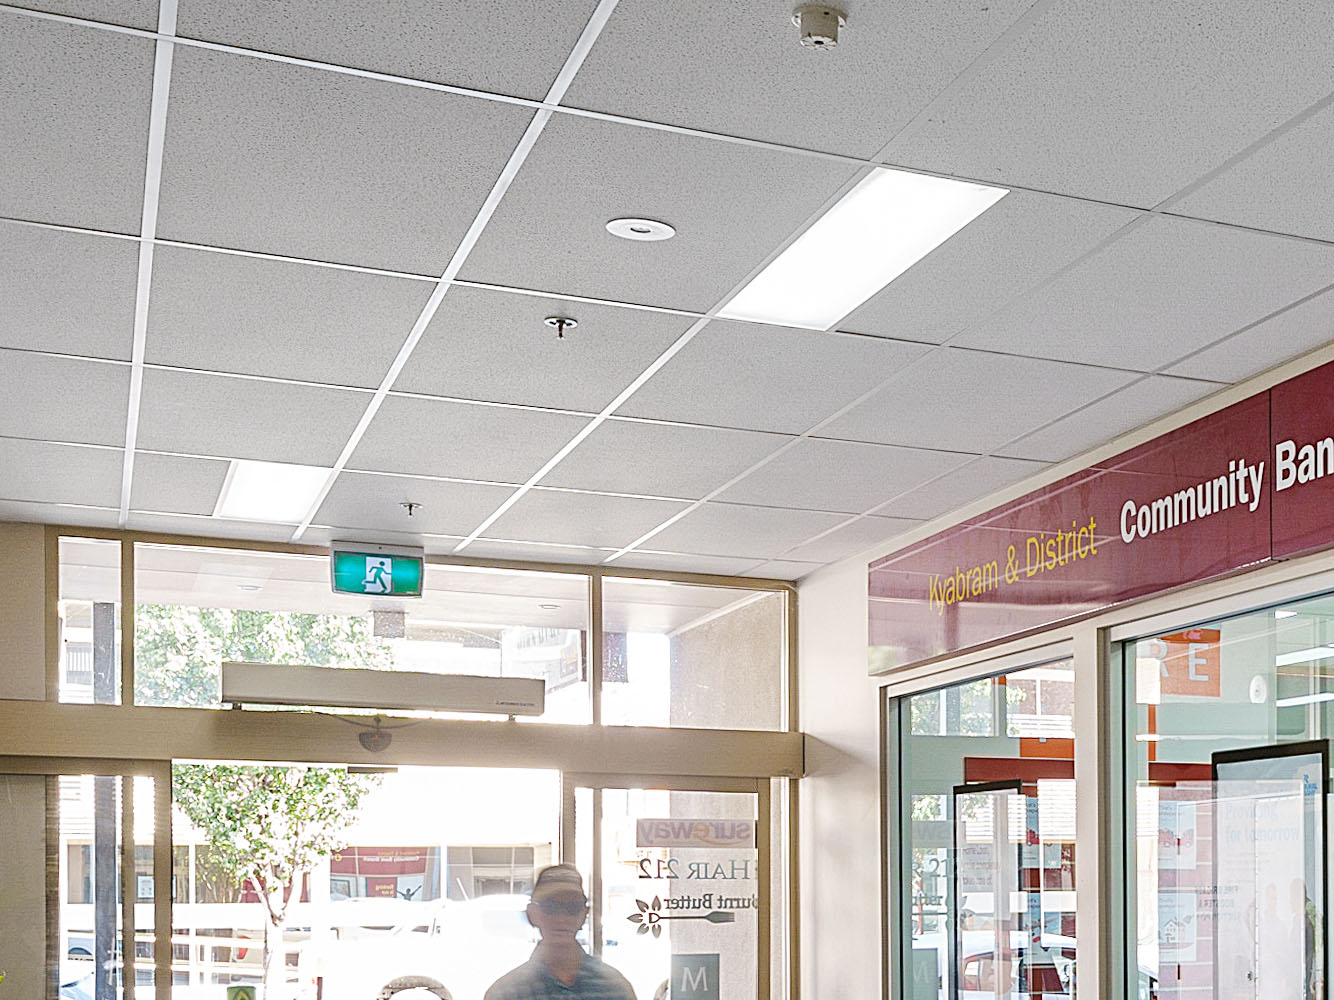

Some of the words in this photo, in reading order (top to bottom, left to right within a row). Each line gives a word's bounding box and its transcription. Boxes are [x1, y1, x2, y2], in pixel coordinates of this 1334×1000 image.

[1120, 459, 1264, 545] Community
[928, 559, 998, 617] Kyabram
[1005, 553, 1020, 584] &
[1024, 515, 1098, 575] District
